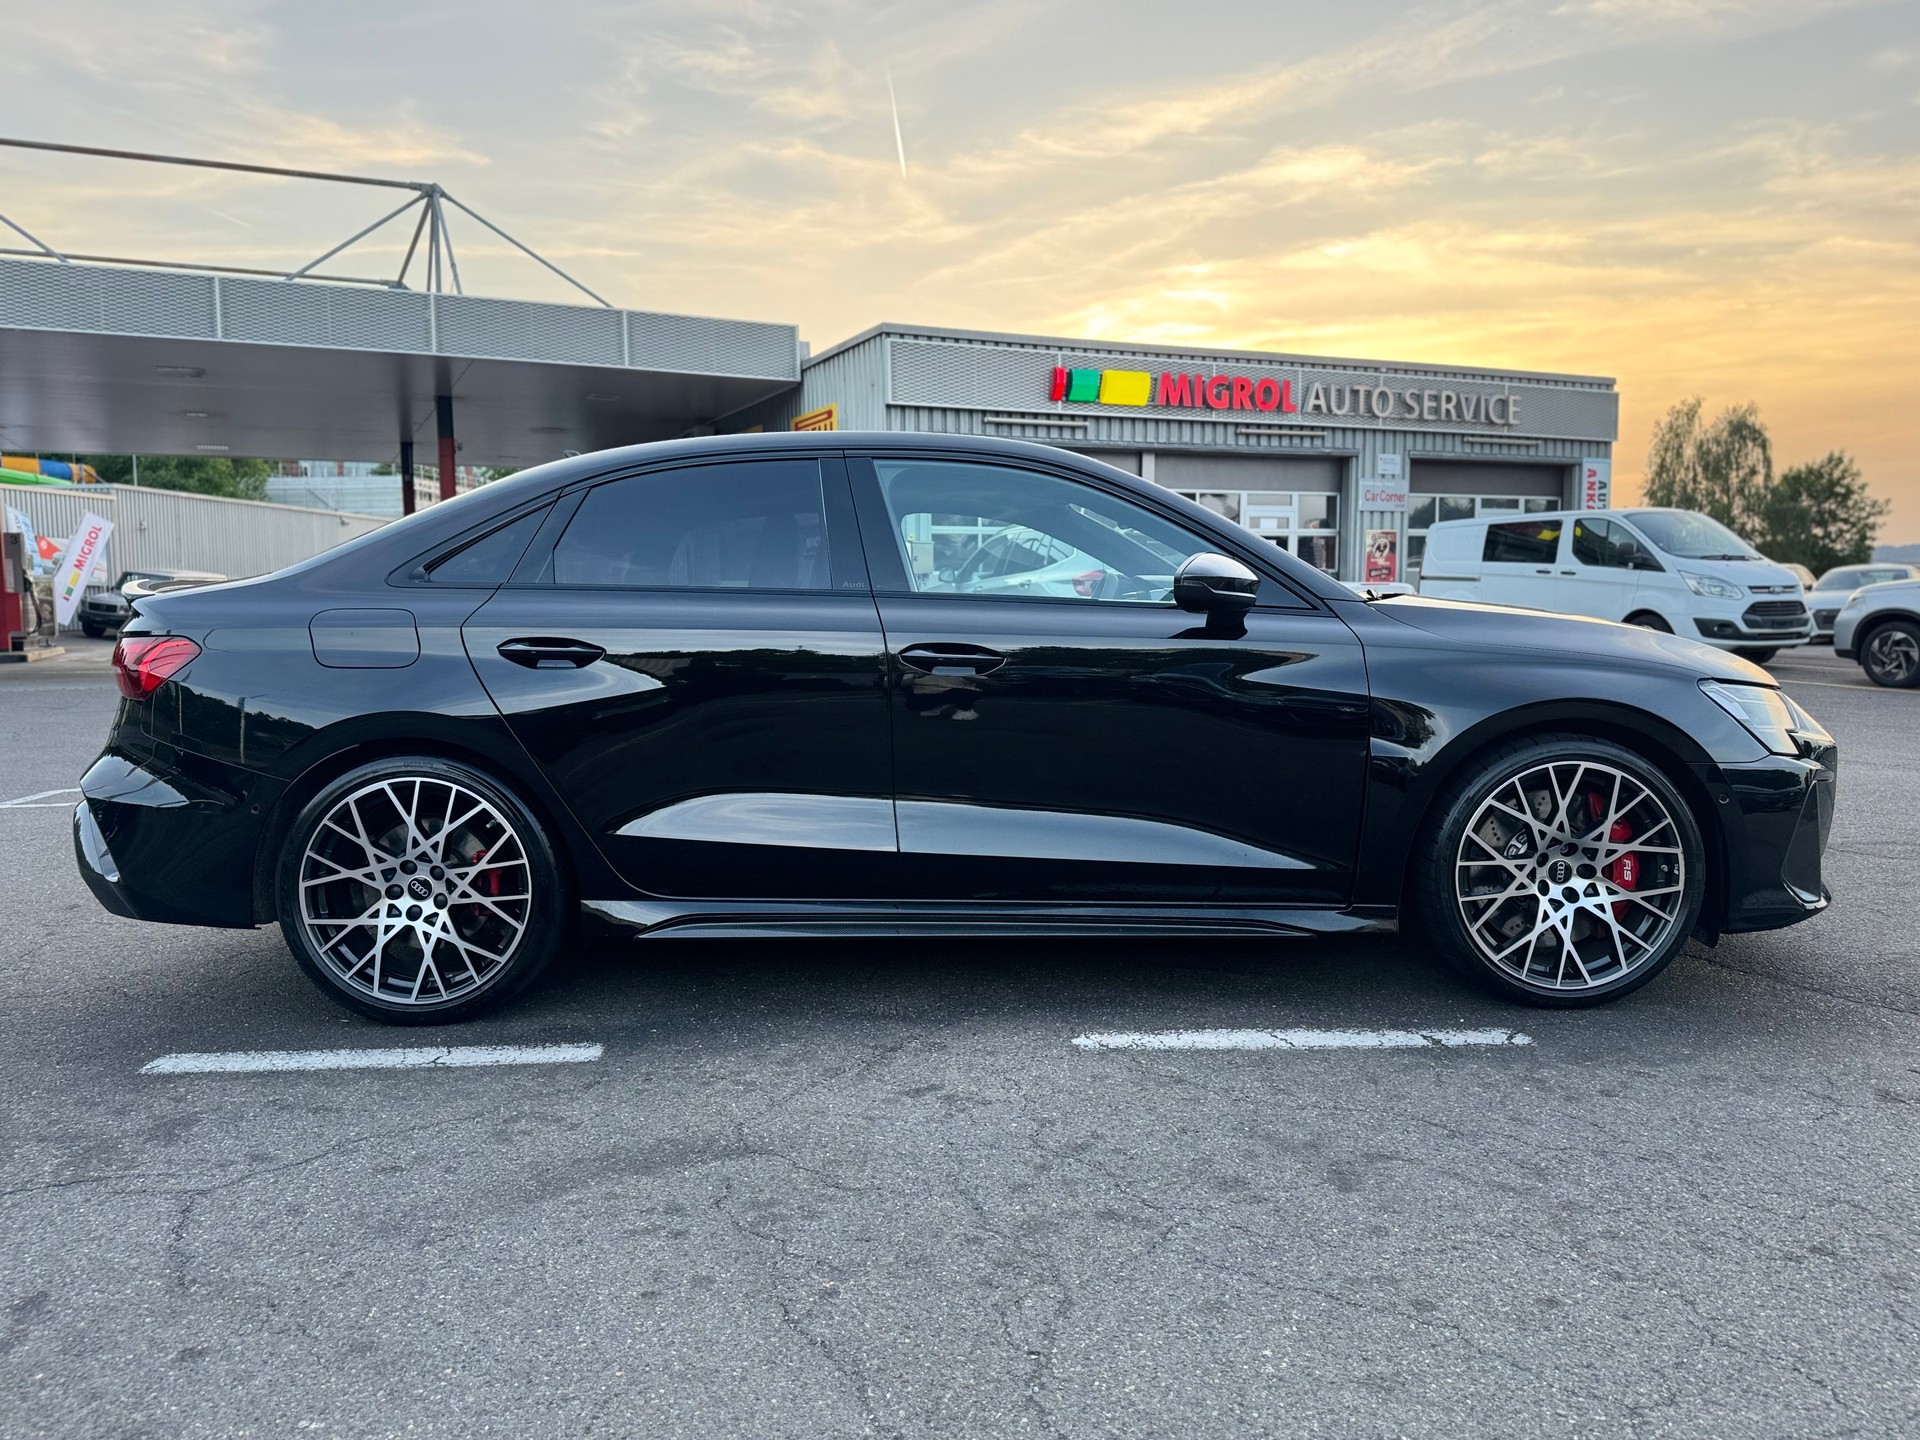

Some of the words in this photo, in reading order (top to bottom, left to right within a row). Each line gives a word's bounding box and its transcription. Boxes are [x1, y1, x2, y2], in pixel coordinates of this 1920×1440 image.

[1157, 371, 1298, 413] MIGROL
[1306, 382, 1394, 418] AUTO
[1404, 388, 1521, 425] SERVICE
[1365, 489, 1379, 502] Car
[1379, 490, 1406, 503] Corner
[10, 535, 18, 545] 3
[73, 526, 102, 571] MIGROL
[1623, 859, 1631, 881] RS
